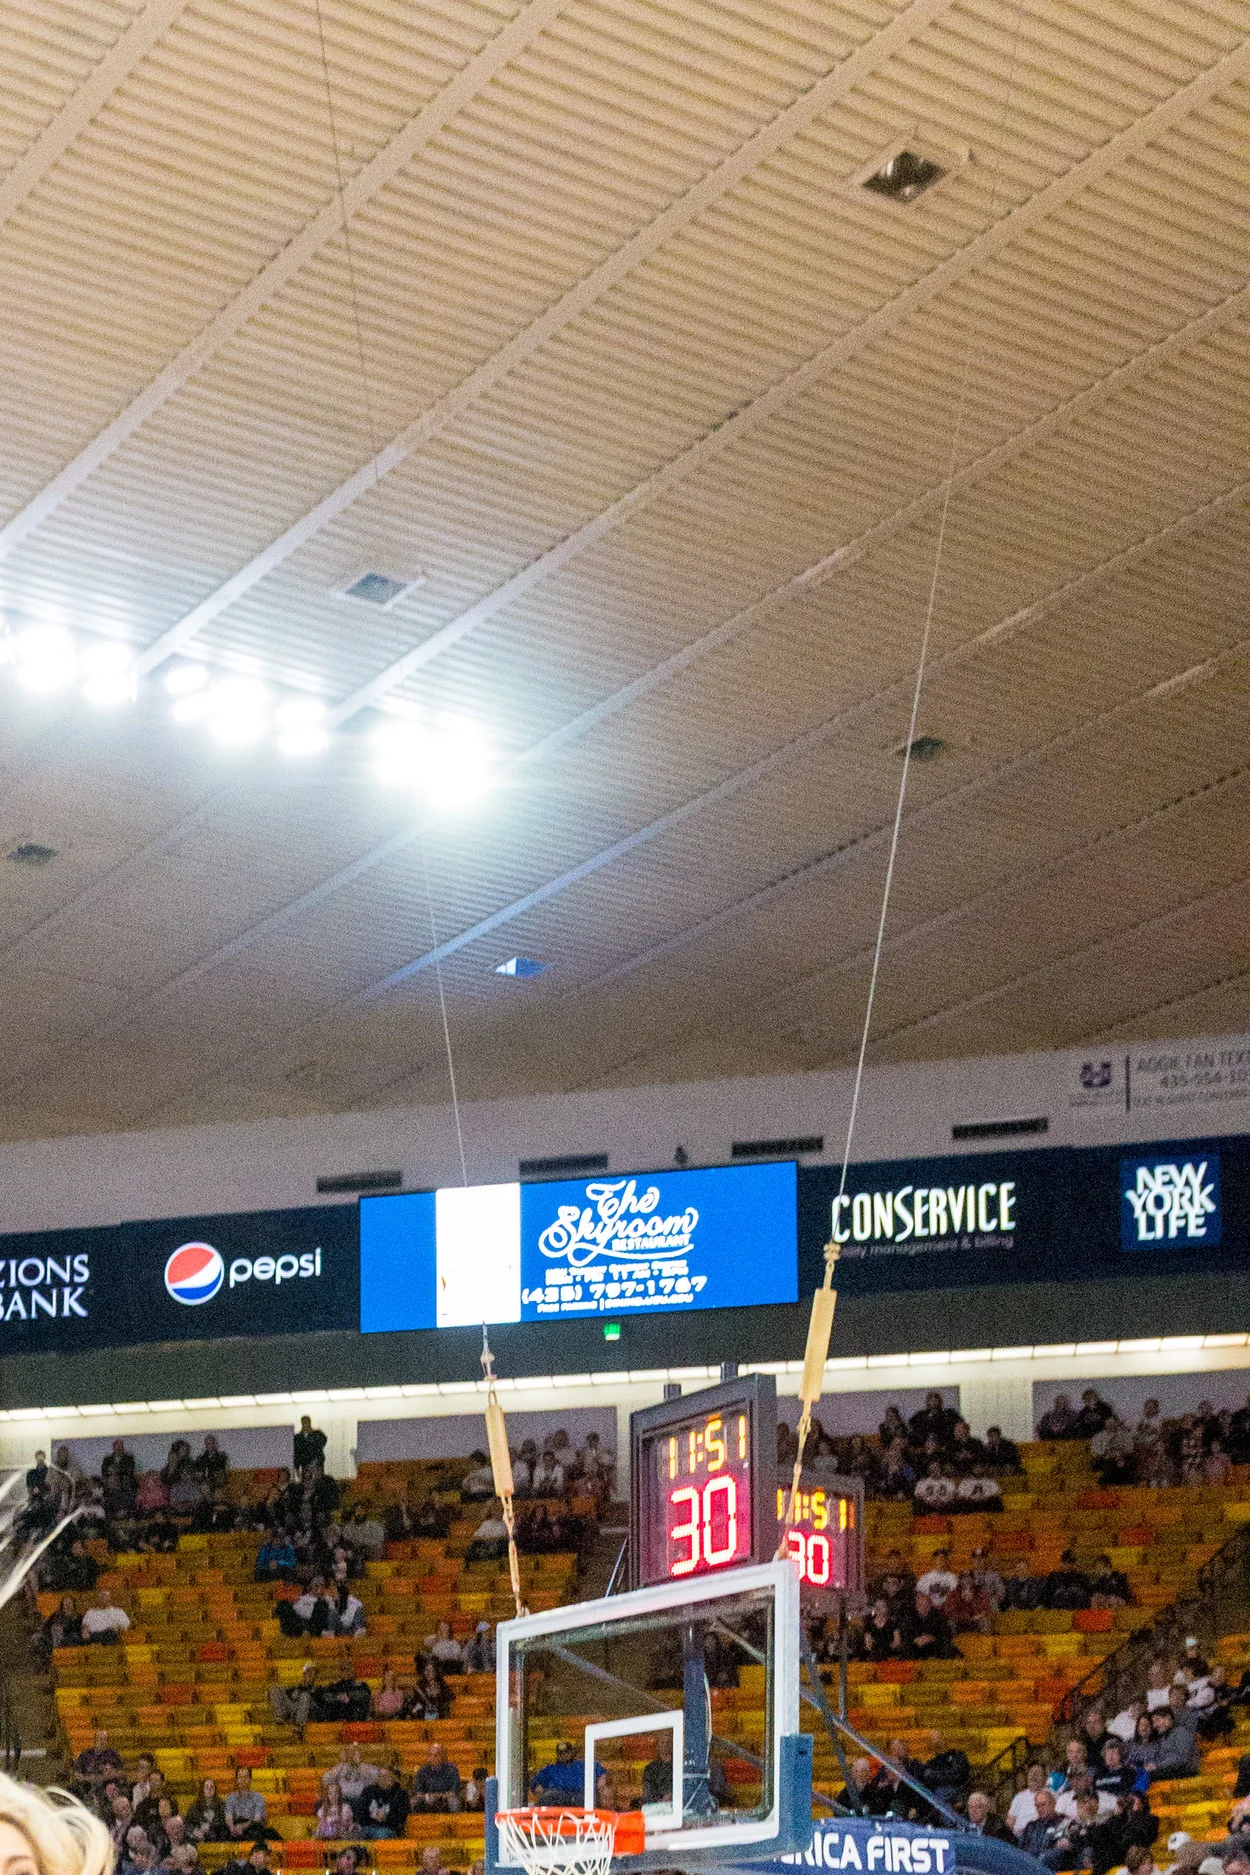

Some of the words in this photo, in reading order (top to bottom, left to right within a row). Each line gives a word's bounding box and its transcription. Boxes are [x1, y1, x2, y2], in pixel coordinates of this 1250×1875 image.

[1136, 1161, 1208, 1195] NEW
[586, 1180, 661, 1225] The
[1125, 1183, 1217, 1219] YORK
[538, 1205, 699, 1266] Skyroom
[1137, 1209, 1208, 1241] LIFE
[229, 1247, 322, 1289] pepsi
[668, 1412, 747, 1481] 11:51
[670, 1474, 738, 1577] 30
[787, 1530, 830, 1585] 30
[866, 1835, 951, 1874] FIRST
